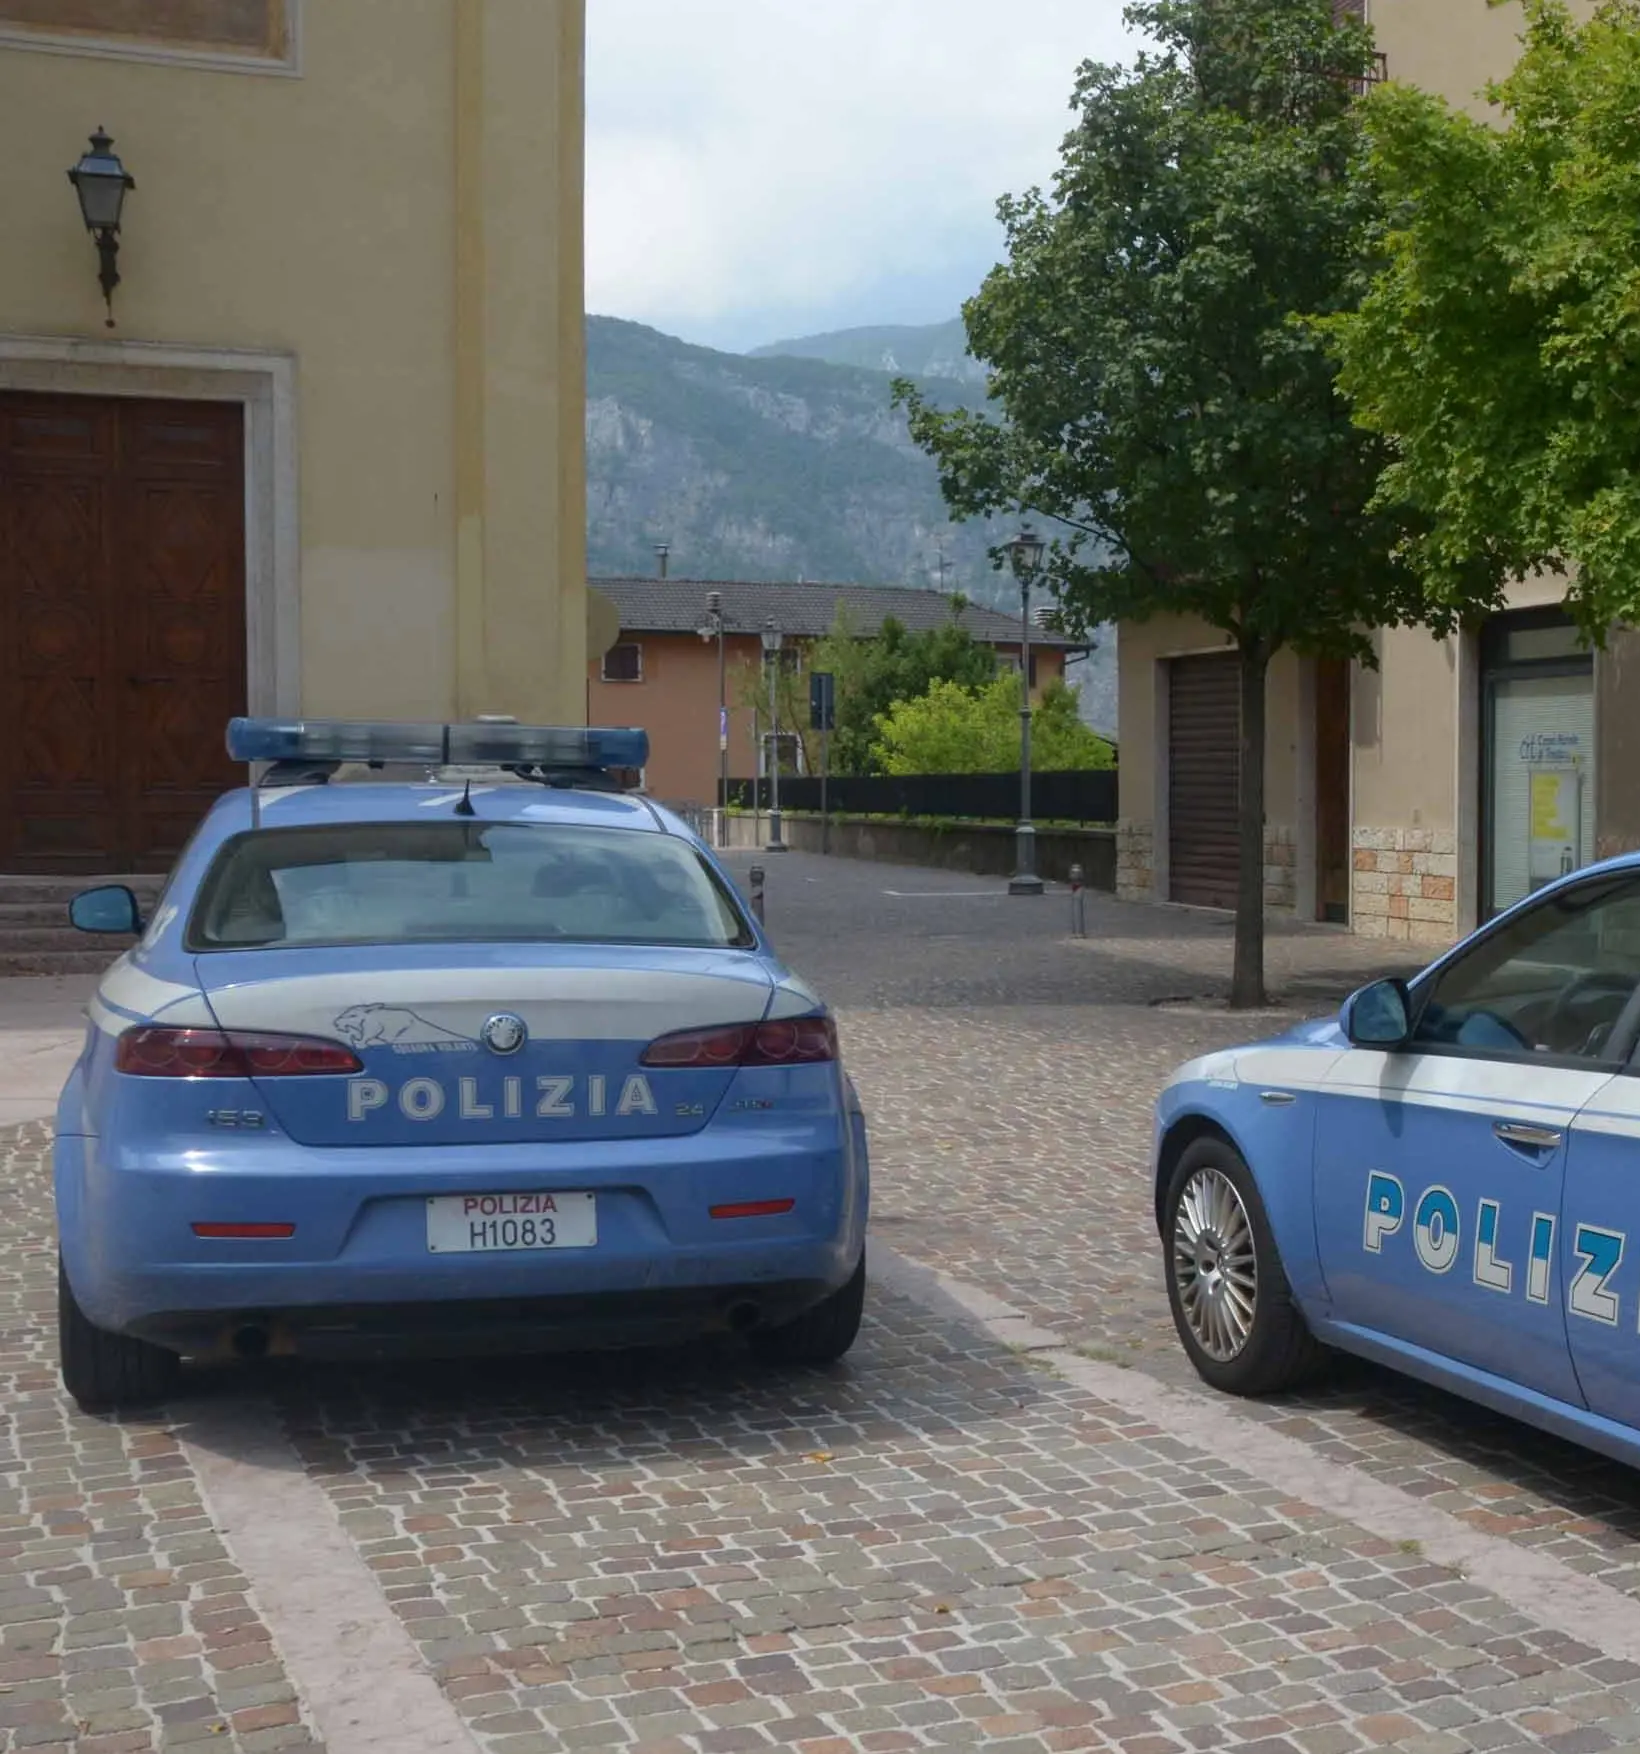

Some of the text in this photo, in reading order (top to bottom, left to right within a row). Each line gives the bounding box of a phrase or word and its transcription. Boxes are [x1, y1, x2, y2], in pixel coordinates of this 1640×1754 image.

[347, 1074, 659, 1122] POLIZIA
[463, 1195, 558, 1217] POLIZIA
[469, 1218, 557, 1249] H1083
